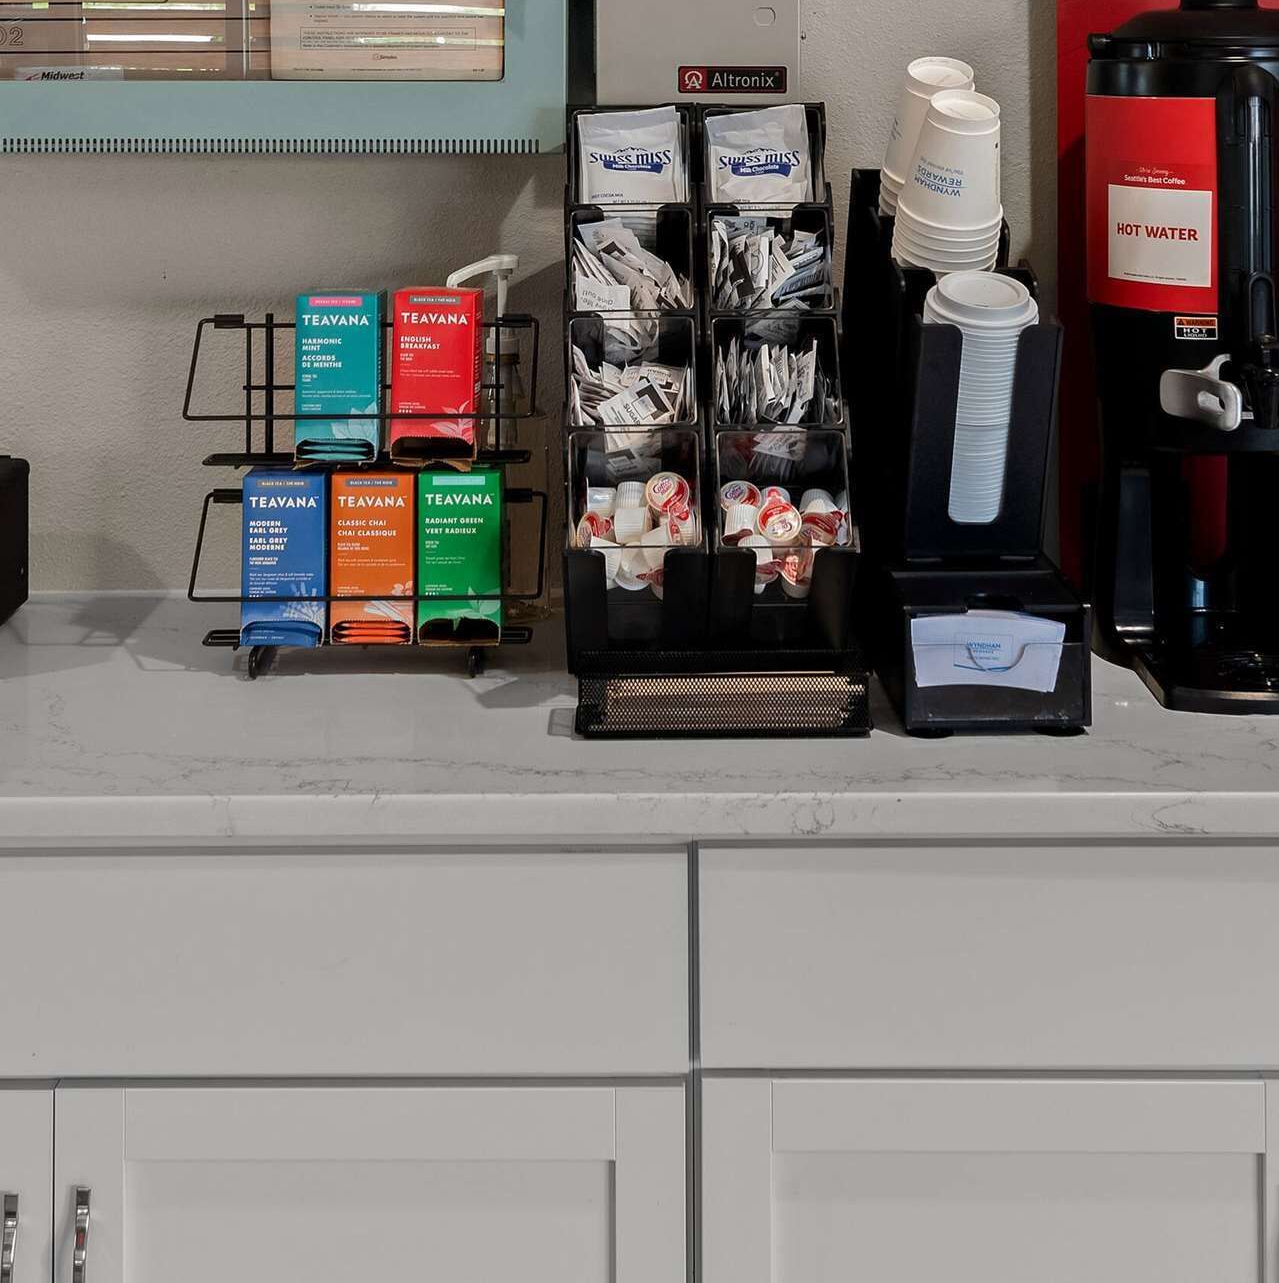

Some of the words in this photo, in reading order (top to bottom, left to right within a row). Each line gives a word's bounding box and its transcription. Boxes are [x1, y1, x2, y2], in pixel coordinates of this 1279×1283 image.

[41, 72, 85, 81] Midwest
[711, 73, 774, 88] Altronix
[1124, 174, 1148, 183] Seattle's
[1148, 176, 1162, 184] Best
[1163, 177, 1186, 186] Coffee
[1117, 222, 1141, 237] HOT
[1145, 225, 1198, 241] WATER
[302, 314, 370, 326] TEAVANA
[401, 312, 468, 325] TEAVANA
[249, 497, 317, 508] TEAVANA
[338, 496, 406, 508] TEAVANA
[425, 494, 493, 506] TEAVANA
